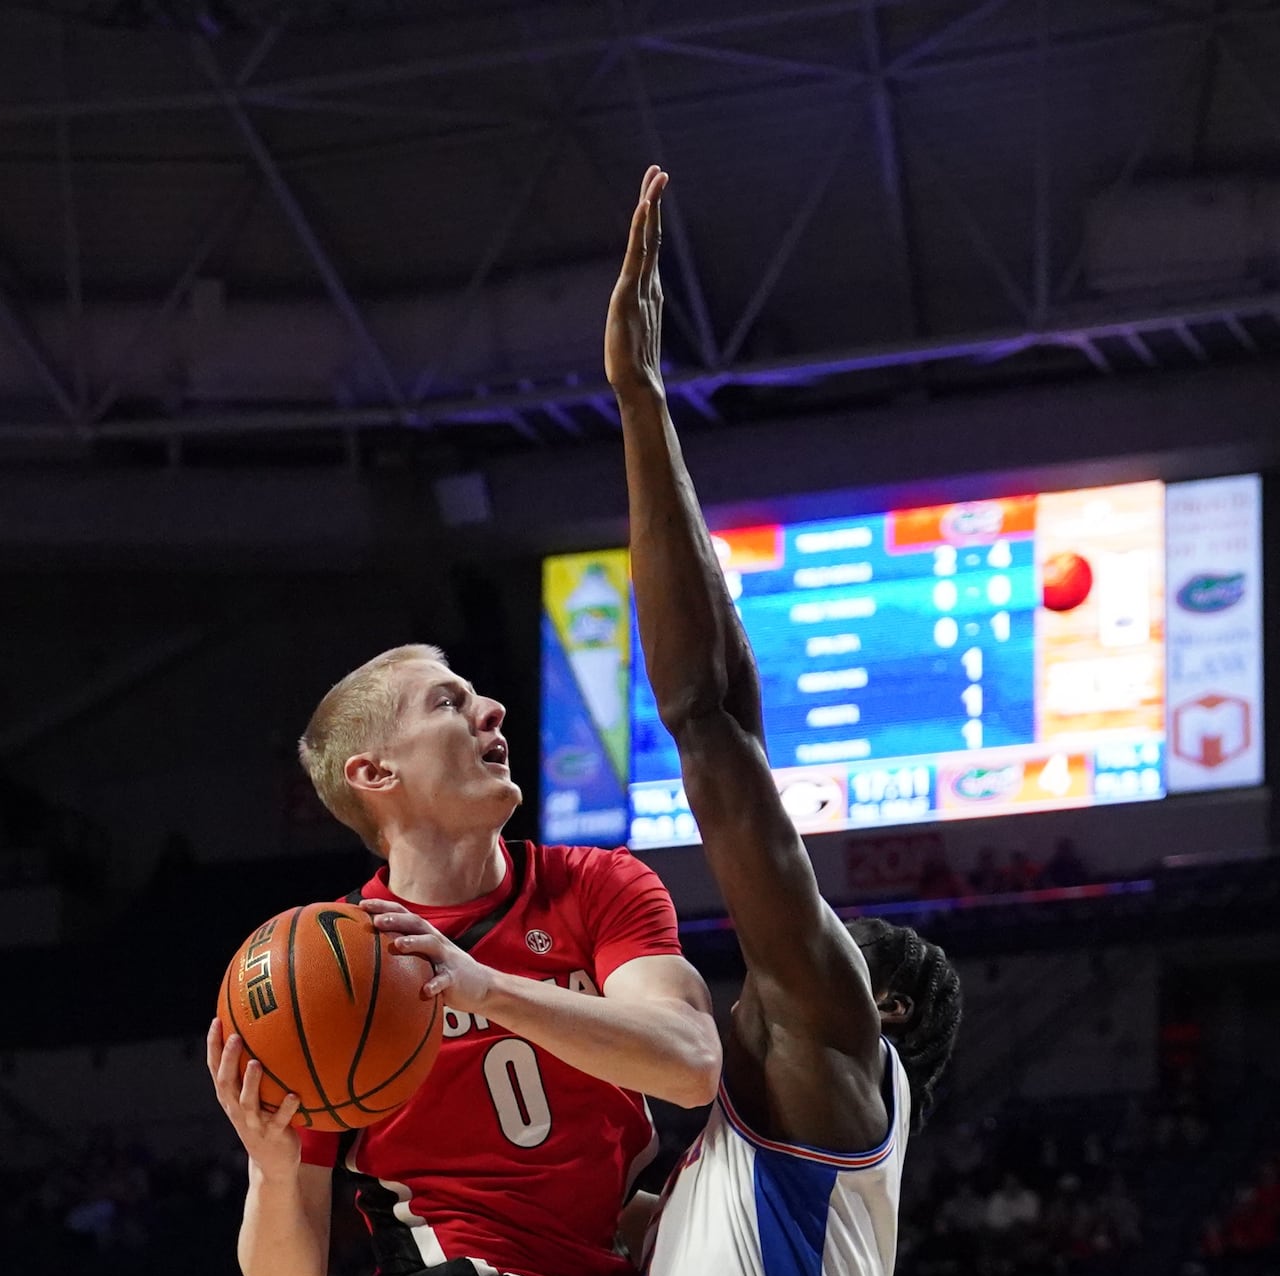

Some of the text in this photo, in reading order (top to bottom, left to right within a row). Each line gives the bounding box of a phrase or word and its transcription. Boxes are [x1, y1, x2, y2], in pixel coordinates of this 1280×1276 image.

[961, 646, 983, 682] 1
[961, 683, 983, 719] 1
[961, 718, 983, 751] 1
[526, 931, 551, 952] SEC
[483, 1037, 552, 1148] 0
